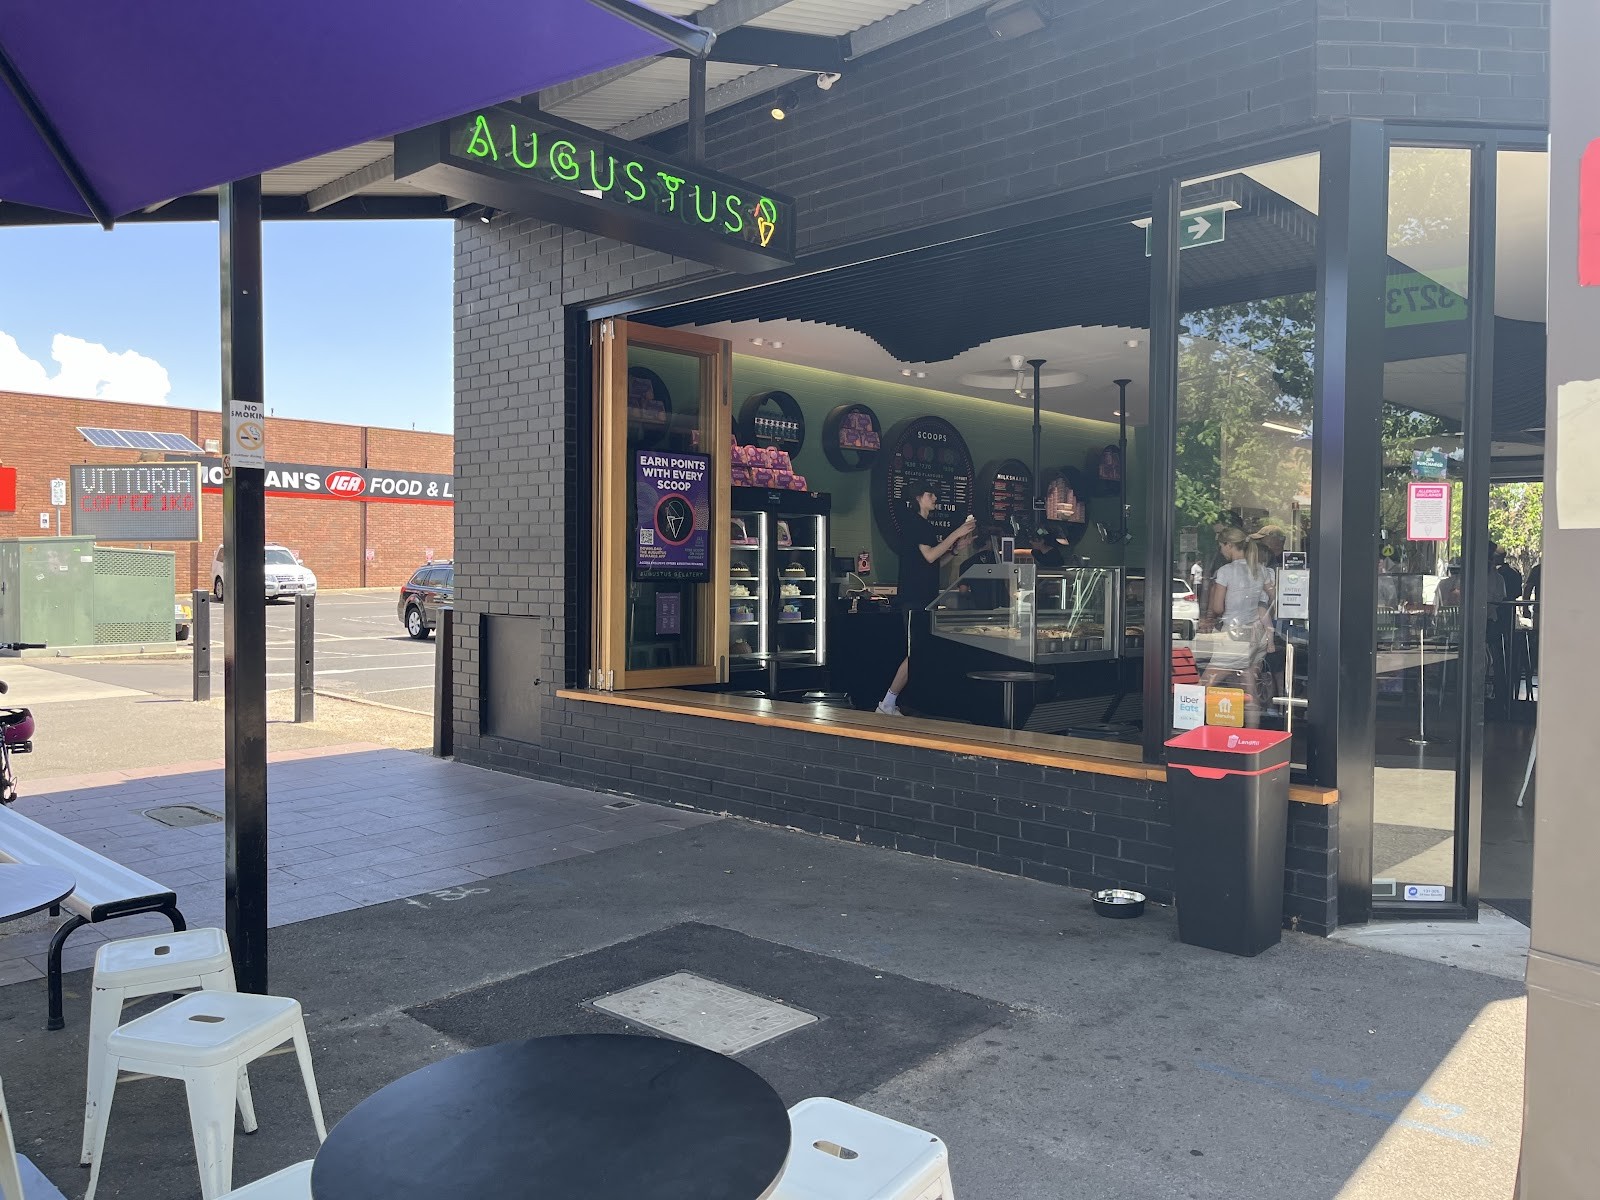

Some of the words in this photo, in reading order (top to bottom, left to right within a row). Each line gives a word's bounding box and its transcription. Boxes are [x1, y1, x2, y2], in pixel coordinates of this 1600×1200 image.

[466, 115, 743, 232] AUGUSTUS
[244, 404, 257, 412] NO
[231, 411, 264, 420] SMOKIN
[917, 431, 947, 442] SCOOPS
[640, 455, 668, 467] EARN
[671, 458, 706, 471] POINTS
[643, 467, 670, 479] WITH
[672, 469, 703, 481] EVERY
[81, 467, 191, 494] VITTORIA
[330, 476, 360, 491] IGA
[370, 477, 423, 496] FOOD
[426, 481, 439, 497] &
[442, 482, 455, 497] L
[657, 480, 691, 491] SCOOP
[80, 494, 155, 512] COFFEE
[160, 493, 195, 512] 1KG
[1180, 695, 1199, 704] Uber
[1180, 703, 1199, 713] Eats
